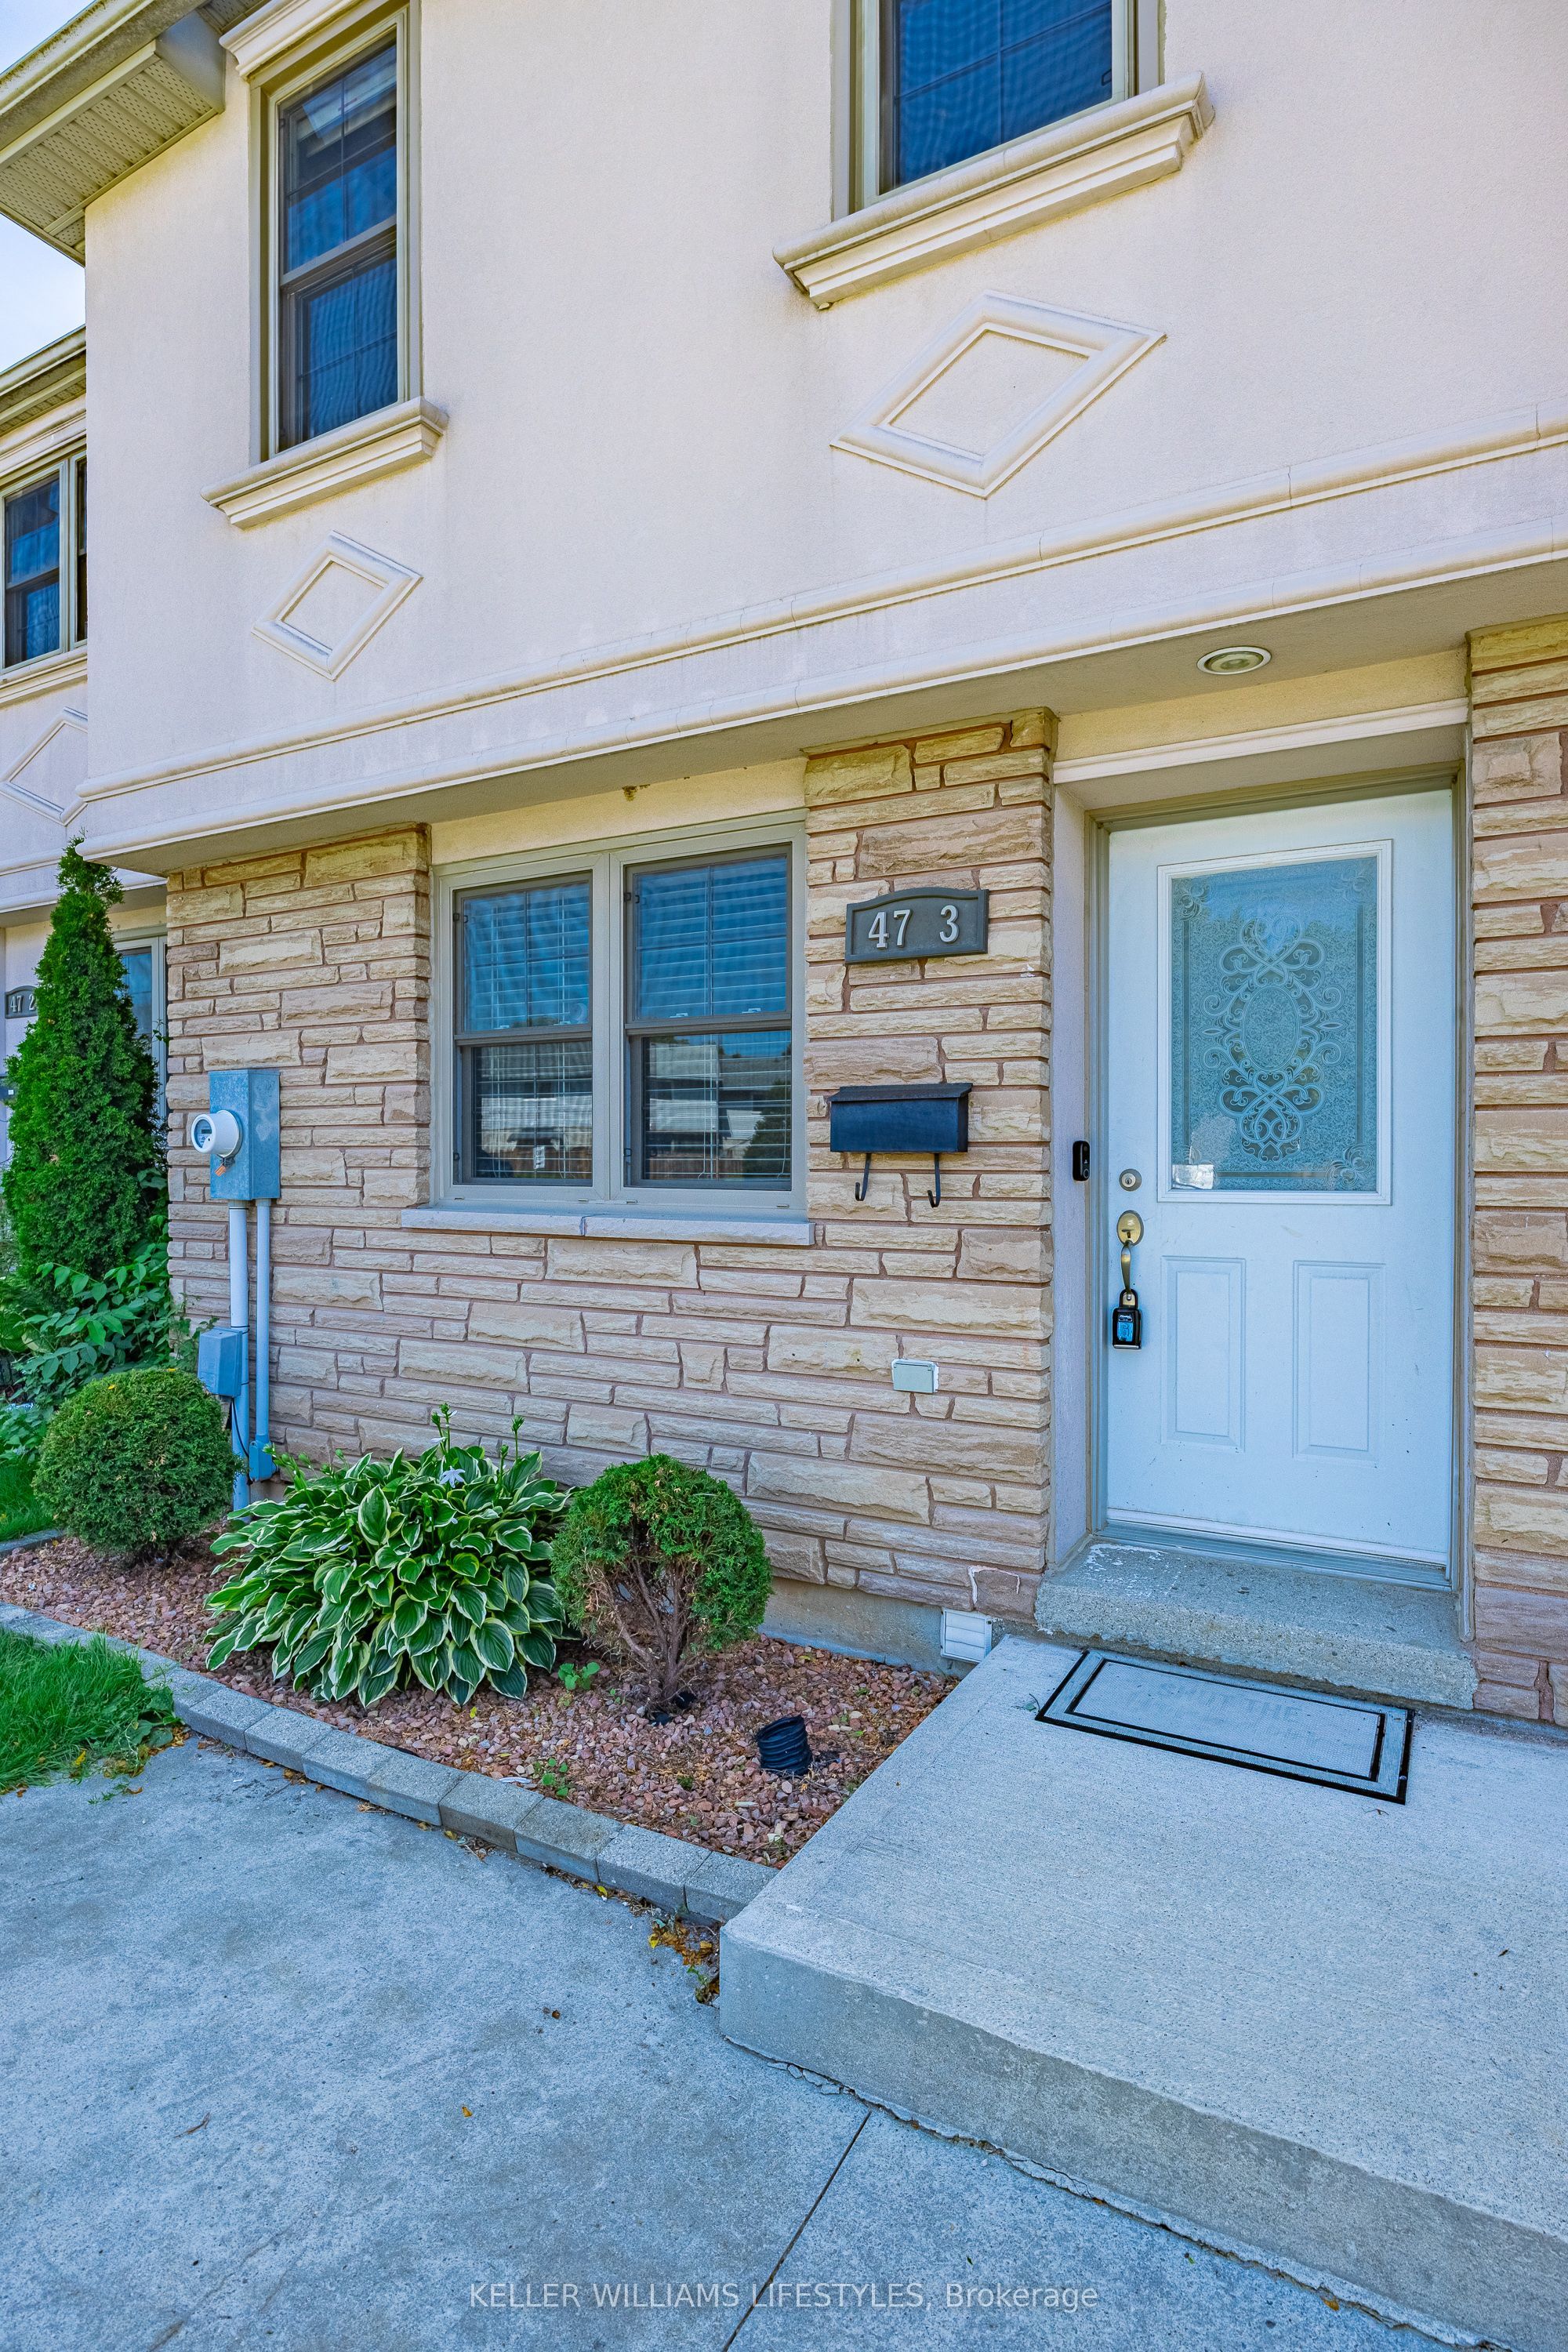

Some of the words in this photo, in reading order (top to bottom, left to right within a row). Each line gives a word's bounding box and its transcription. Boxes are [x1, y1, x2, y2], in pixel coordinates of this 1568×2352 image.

[868, 909, 912, 949] 47
[939, 905, 960, 943] 3
[10, 995, 23, 1013] 47
[28, 993, 35, 1011] 2
